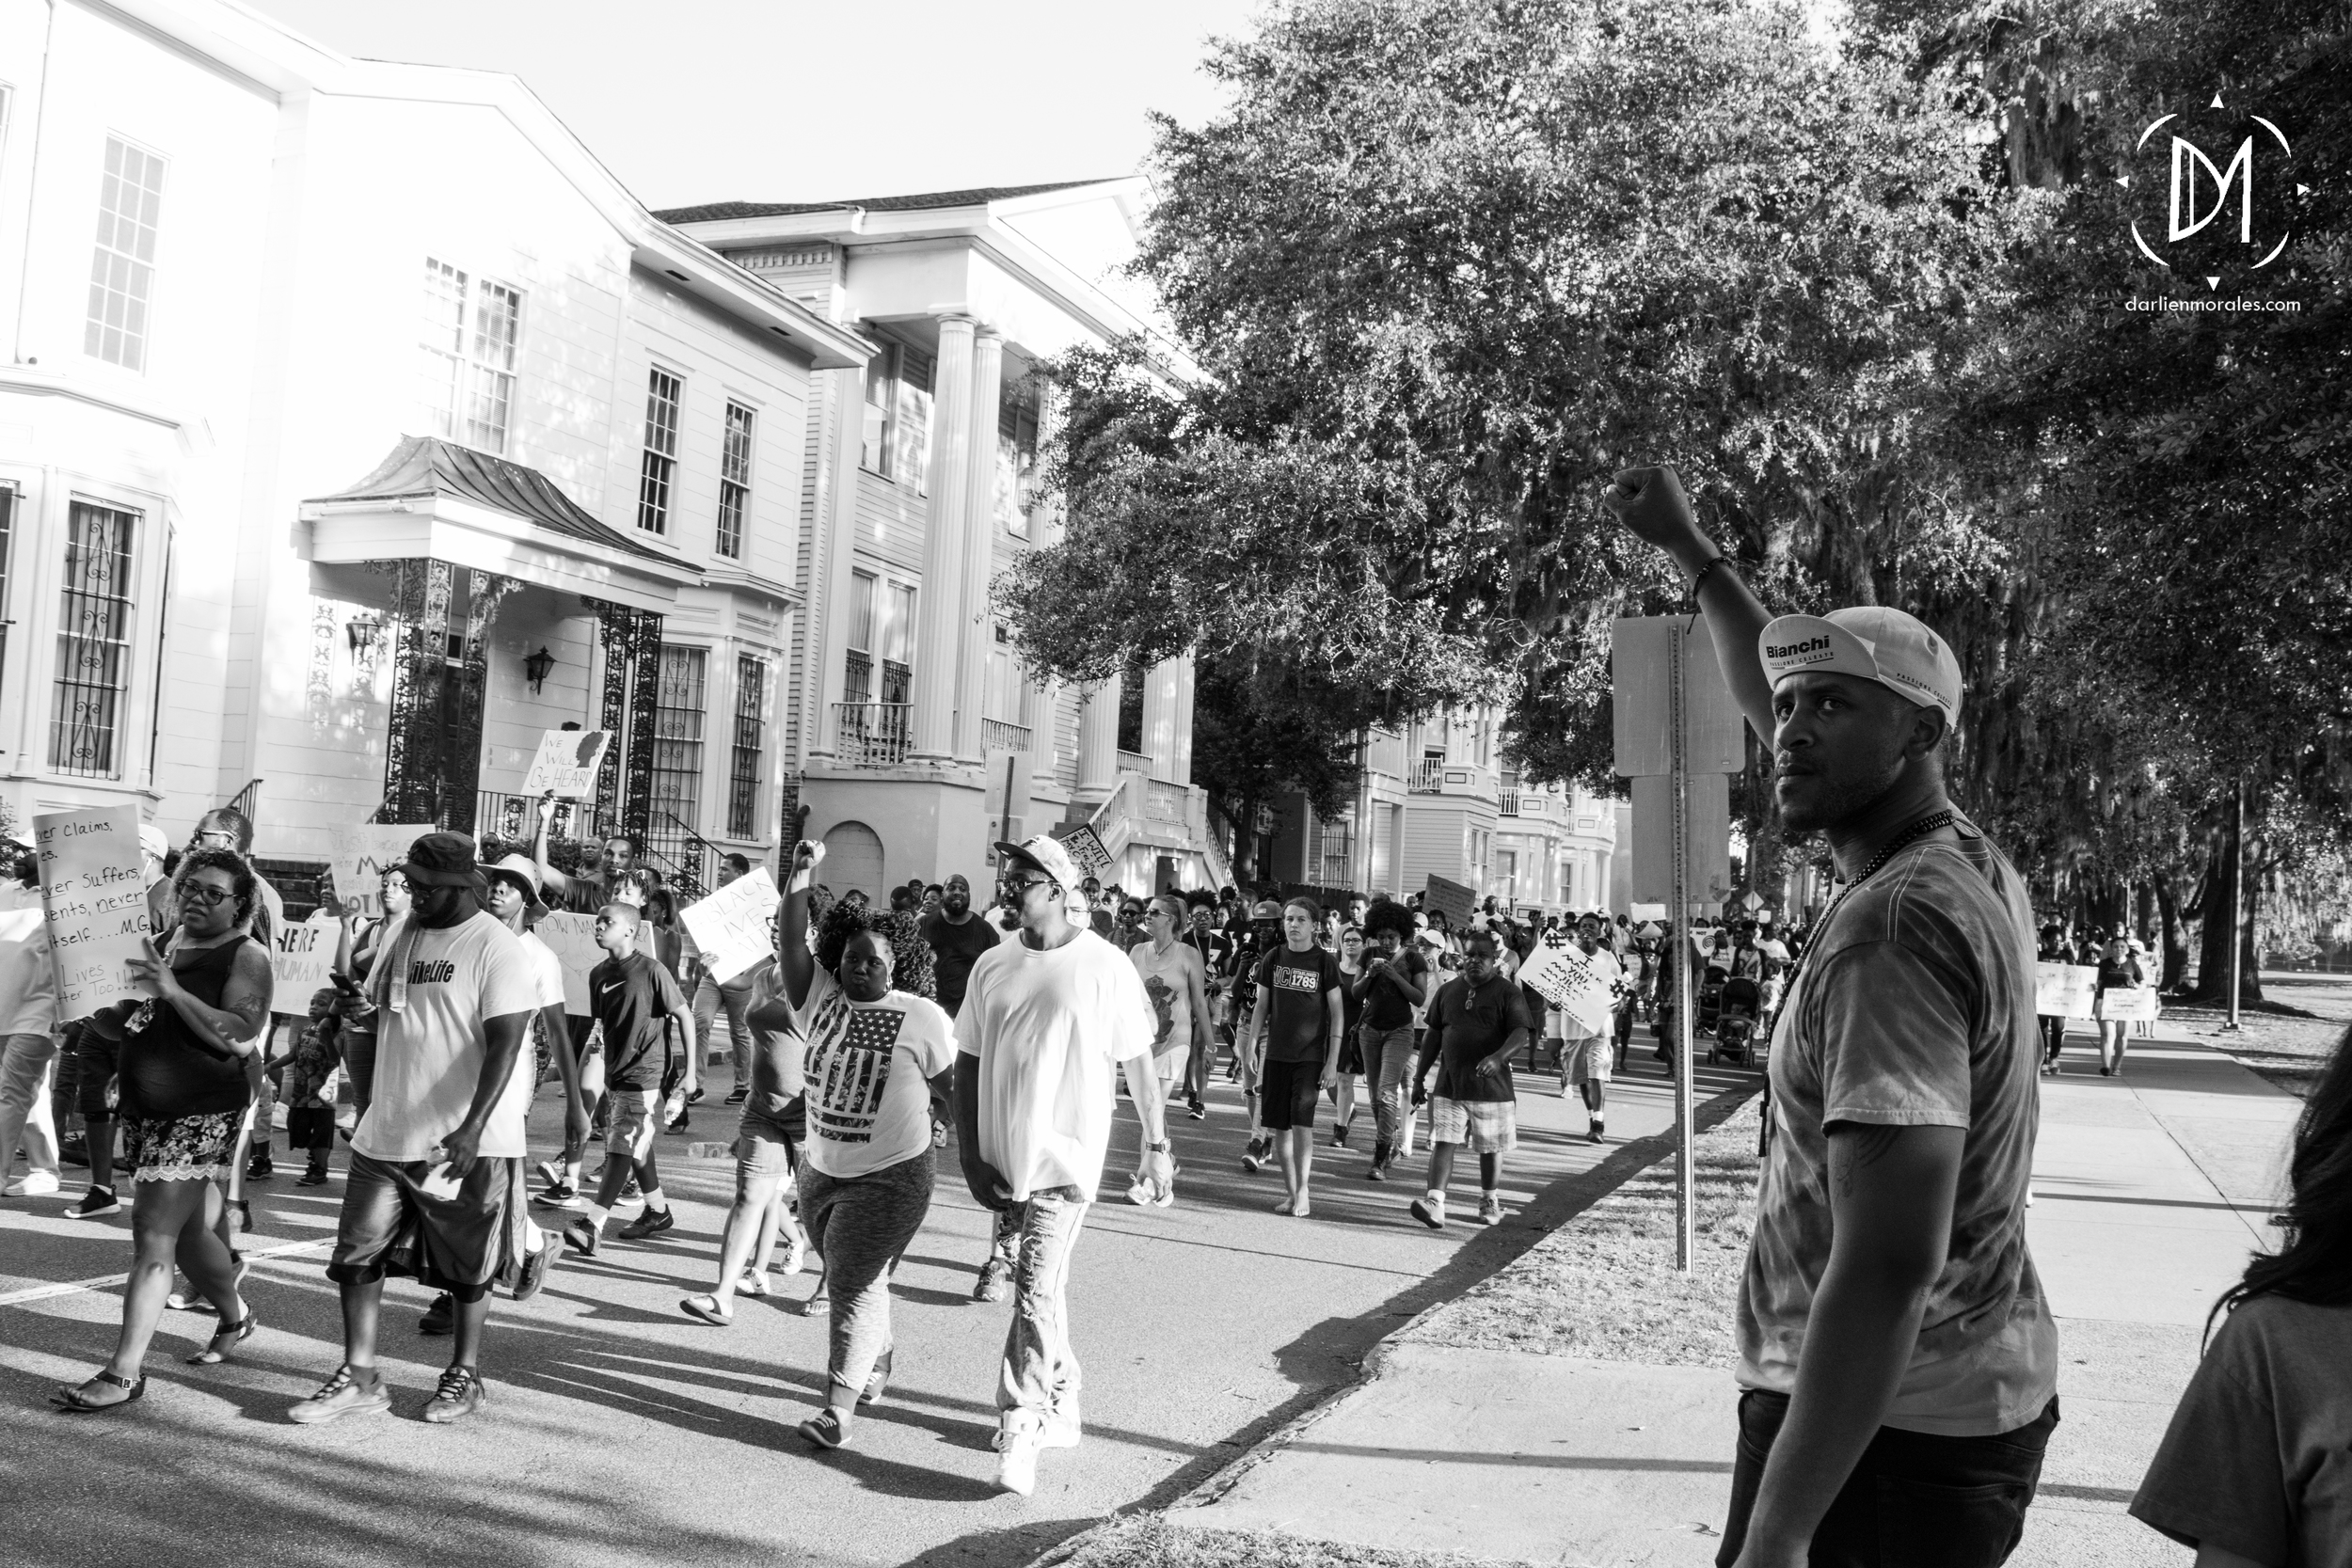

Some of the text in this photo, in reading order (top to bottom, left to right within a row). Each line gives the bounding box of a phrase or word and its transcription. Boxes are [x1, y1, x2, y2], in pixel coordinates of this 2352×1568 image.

[1766, 635, 1830, 657] Bianchi
[1799, 652, 1834, 662] CELESTE
[546, 734, 563, 748] WE
[546, 751, 574, 766] WILL
[551, 768, 592, 787] HEARD
[328, 828, 412, 853] Just becaus
[1077, 829, 1110, 868] I WILL
[40, 850, 58, 862] es.
[95, 892, 143, 913] never
[536, 915, 597, 936] HOW MAN
[61, 964, 104, 987] Lives
[1291, 974, 1316, 990] 1789
